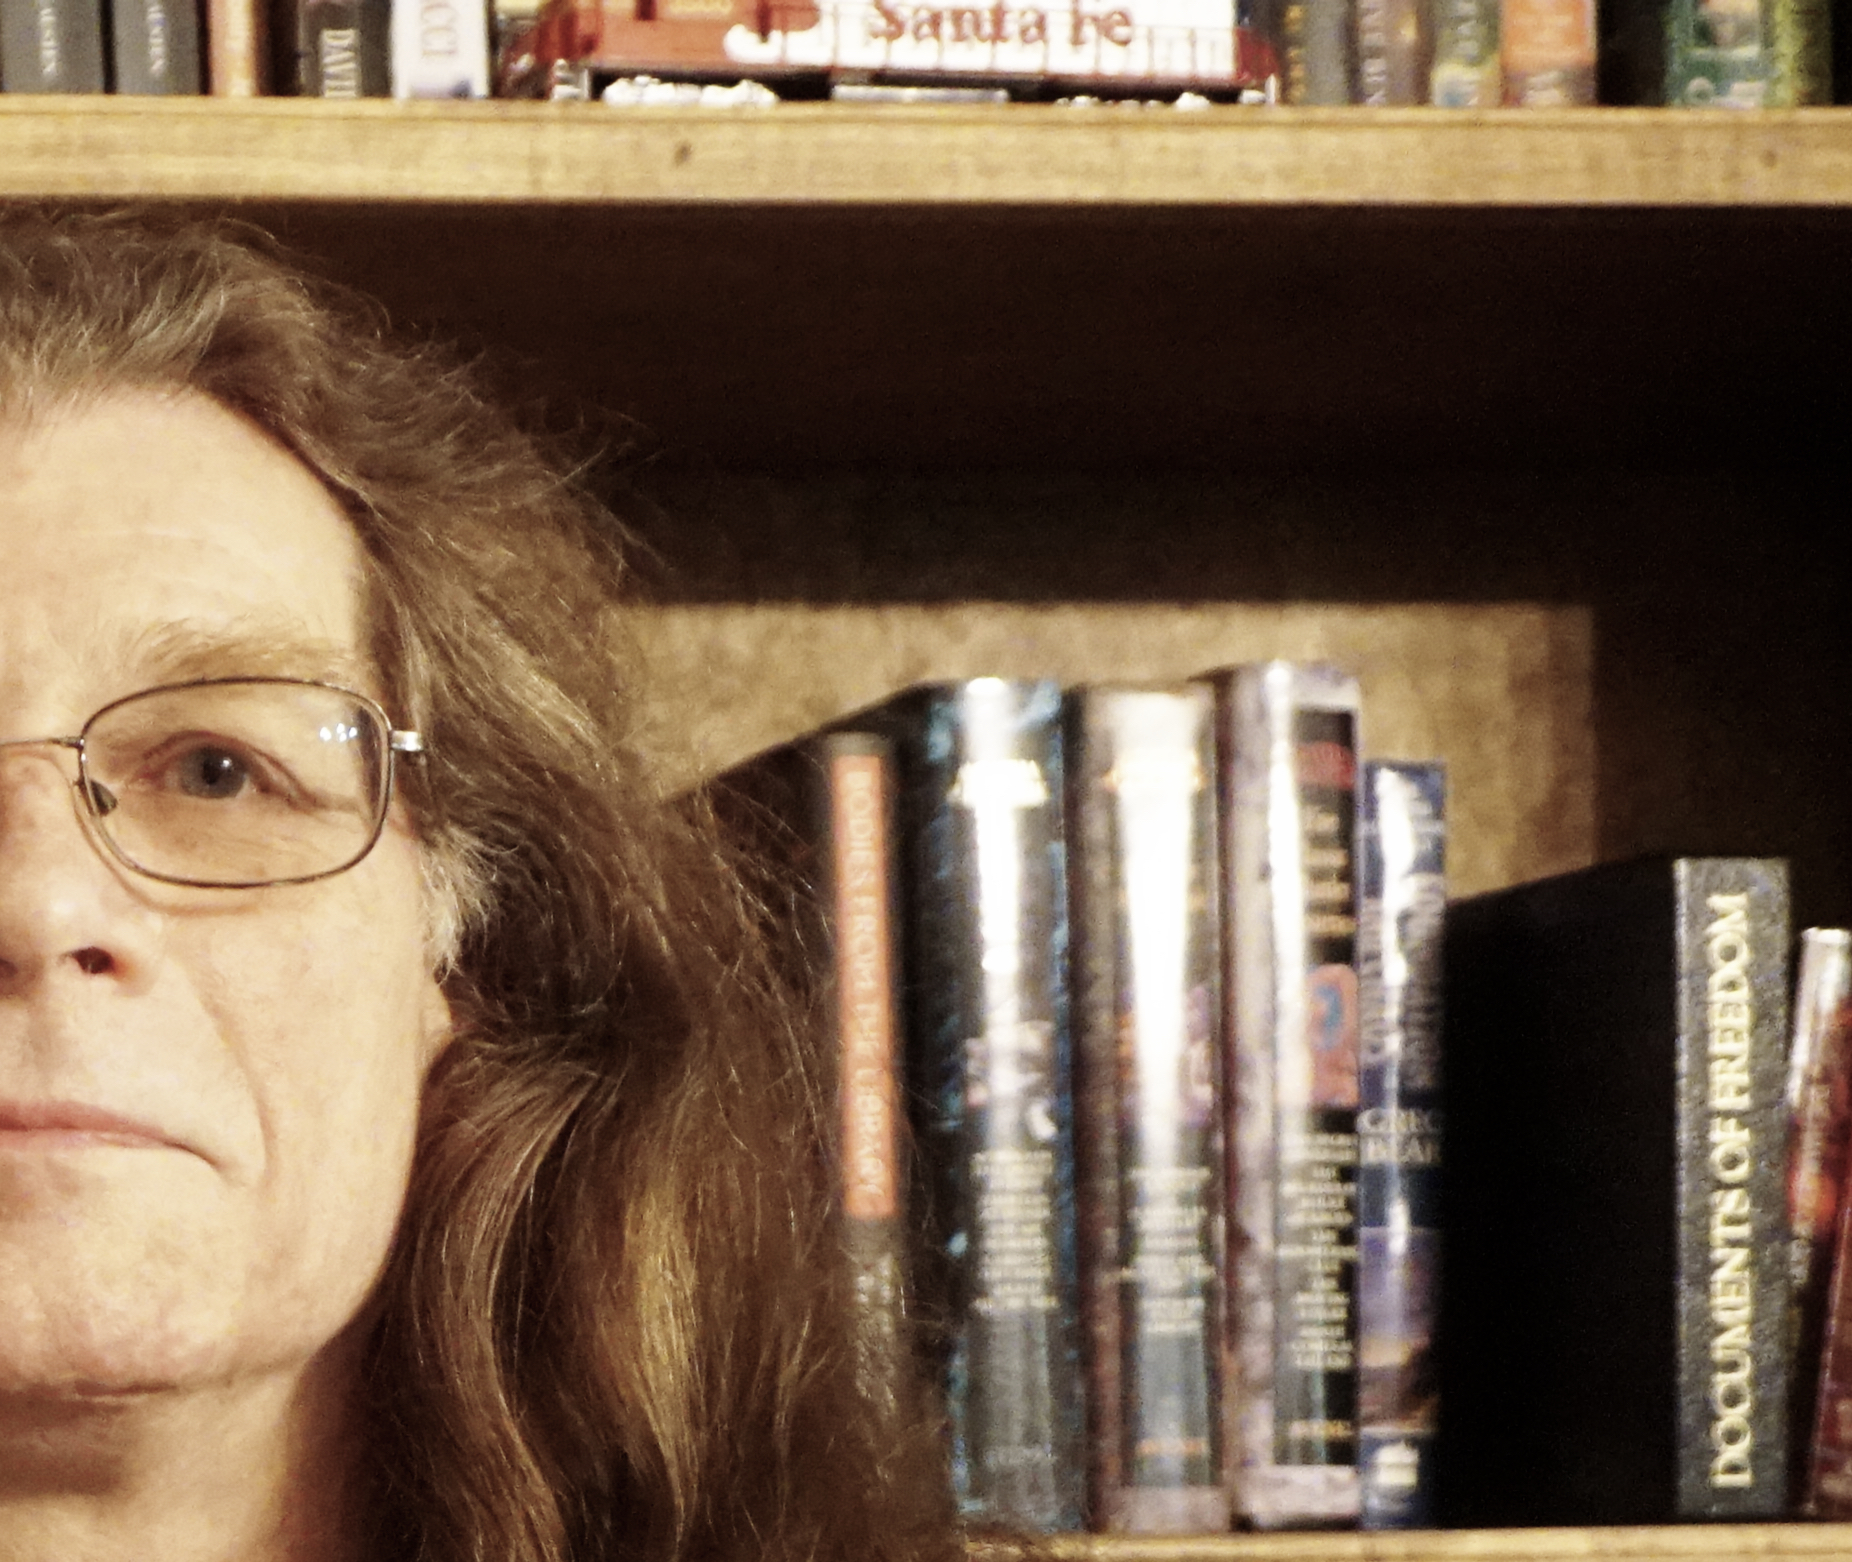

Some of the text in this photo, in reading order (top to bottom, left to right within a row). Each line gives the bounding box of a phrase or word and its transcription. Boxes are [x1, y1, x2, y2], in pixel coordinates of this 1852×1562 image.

[851, 769, 886, 1197] BODIES FROM THE LIBRARY
[1705, 891, 1754, 1488] DOCUMENTS OF FREEDOM
